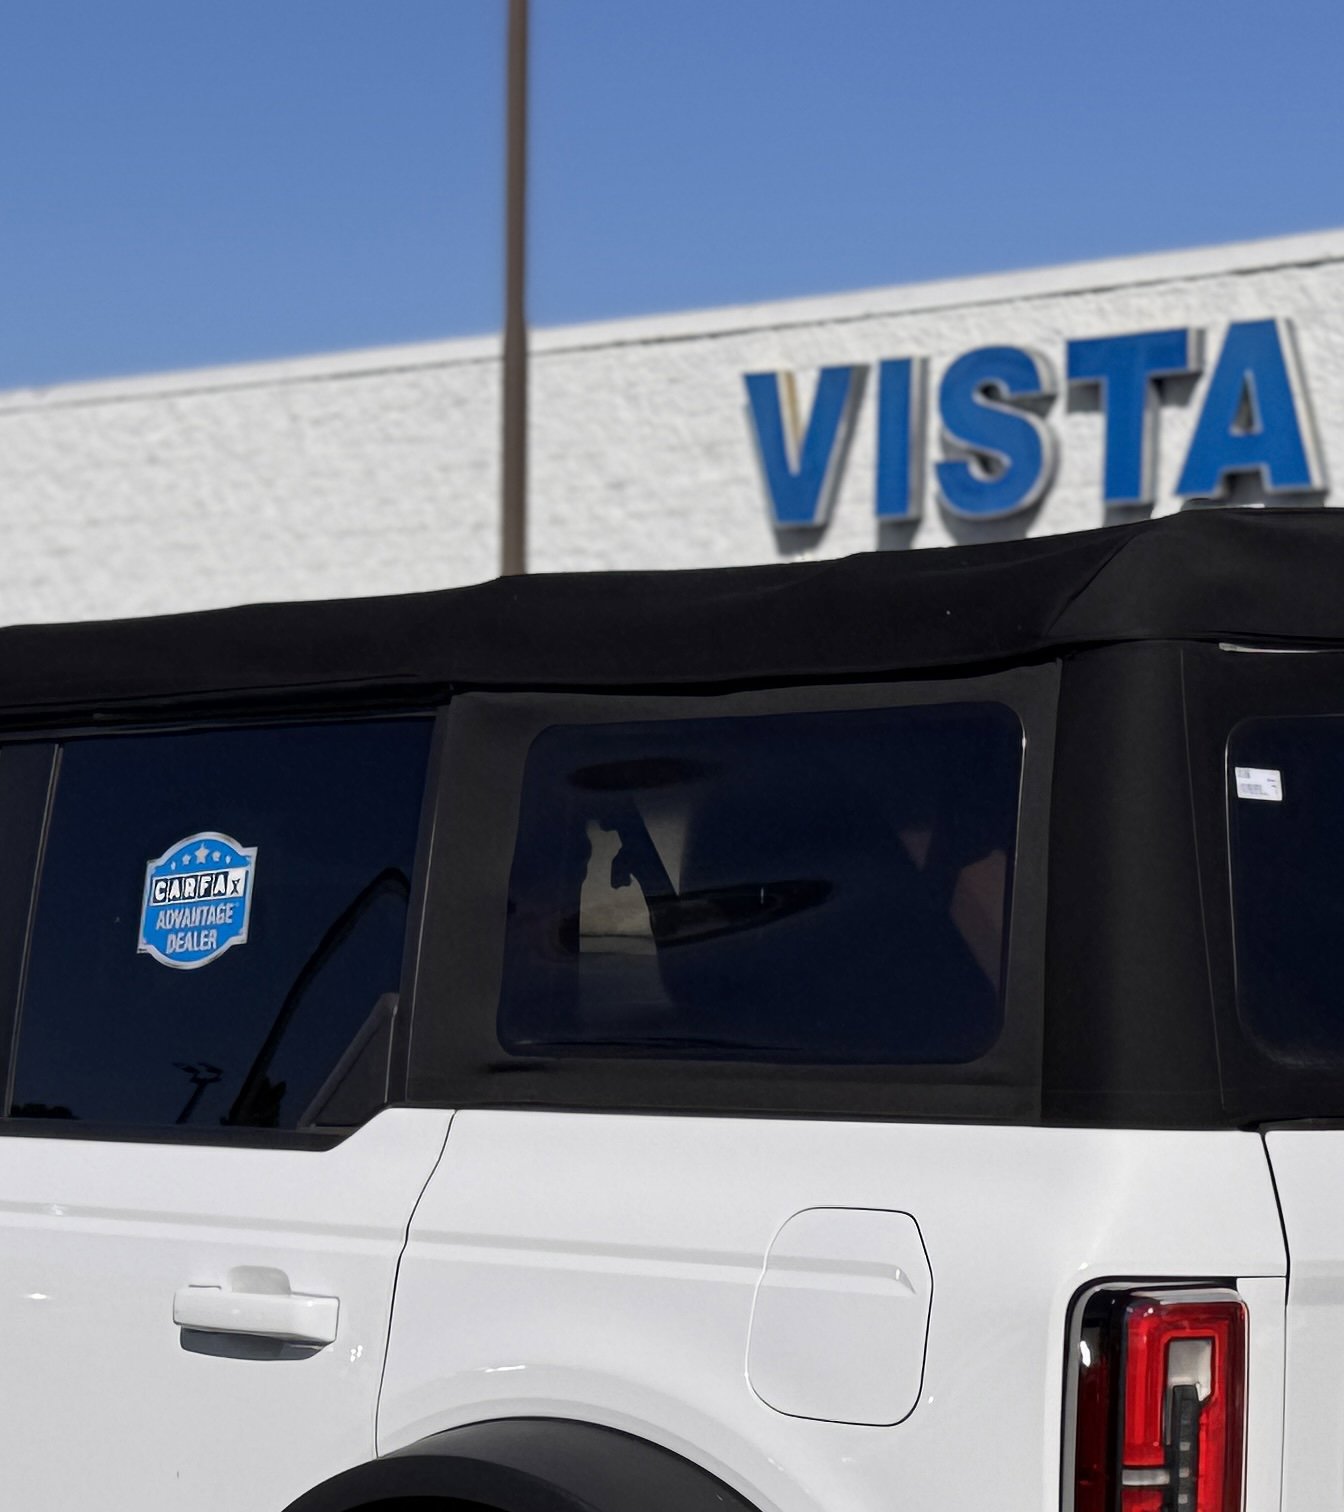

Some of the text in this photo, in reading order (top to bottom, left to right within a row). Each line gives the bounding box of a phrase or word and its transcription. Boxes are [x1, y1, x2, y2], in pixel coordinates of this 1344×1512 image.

[742, 317, 1329, 527] VISTA
[153, 871, 244, 903] CARFAX
[156, 904, 233, 930] ADVANTAGE
[166, 930, 218, 954] DEALER
